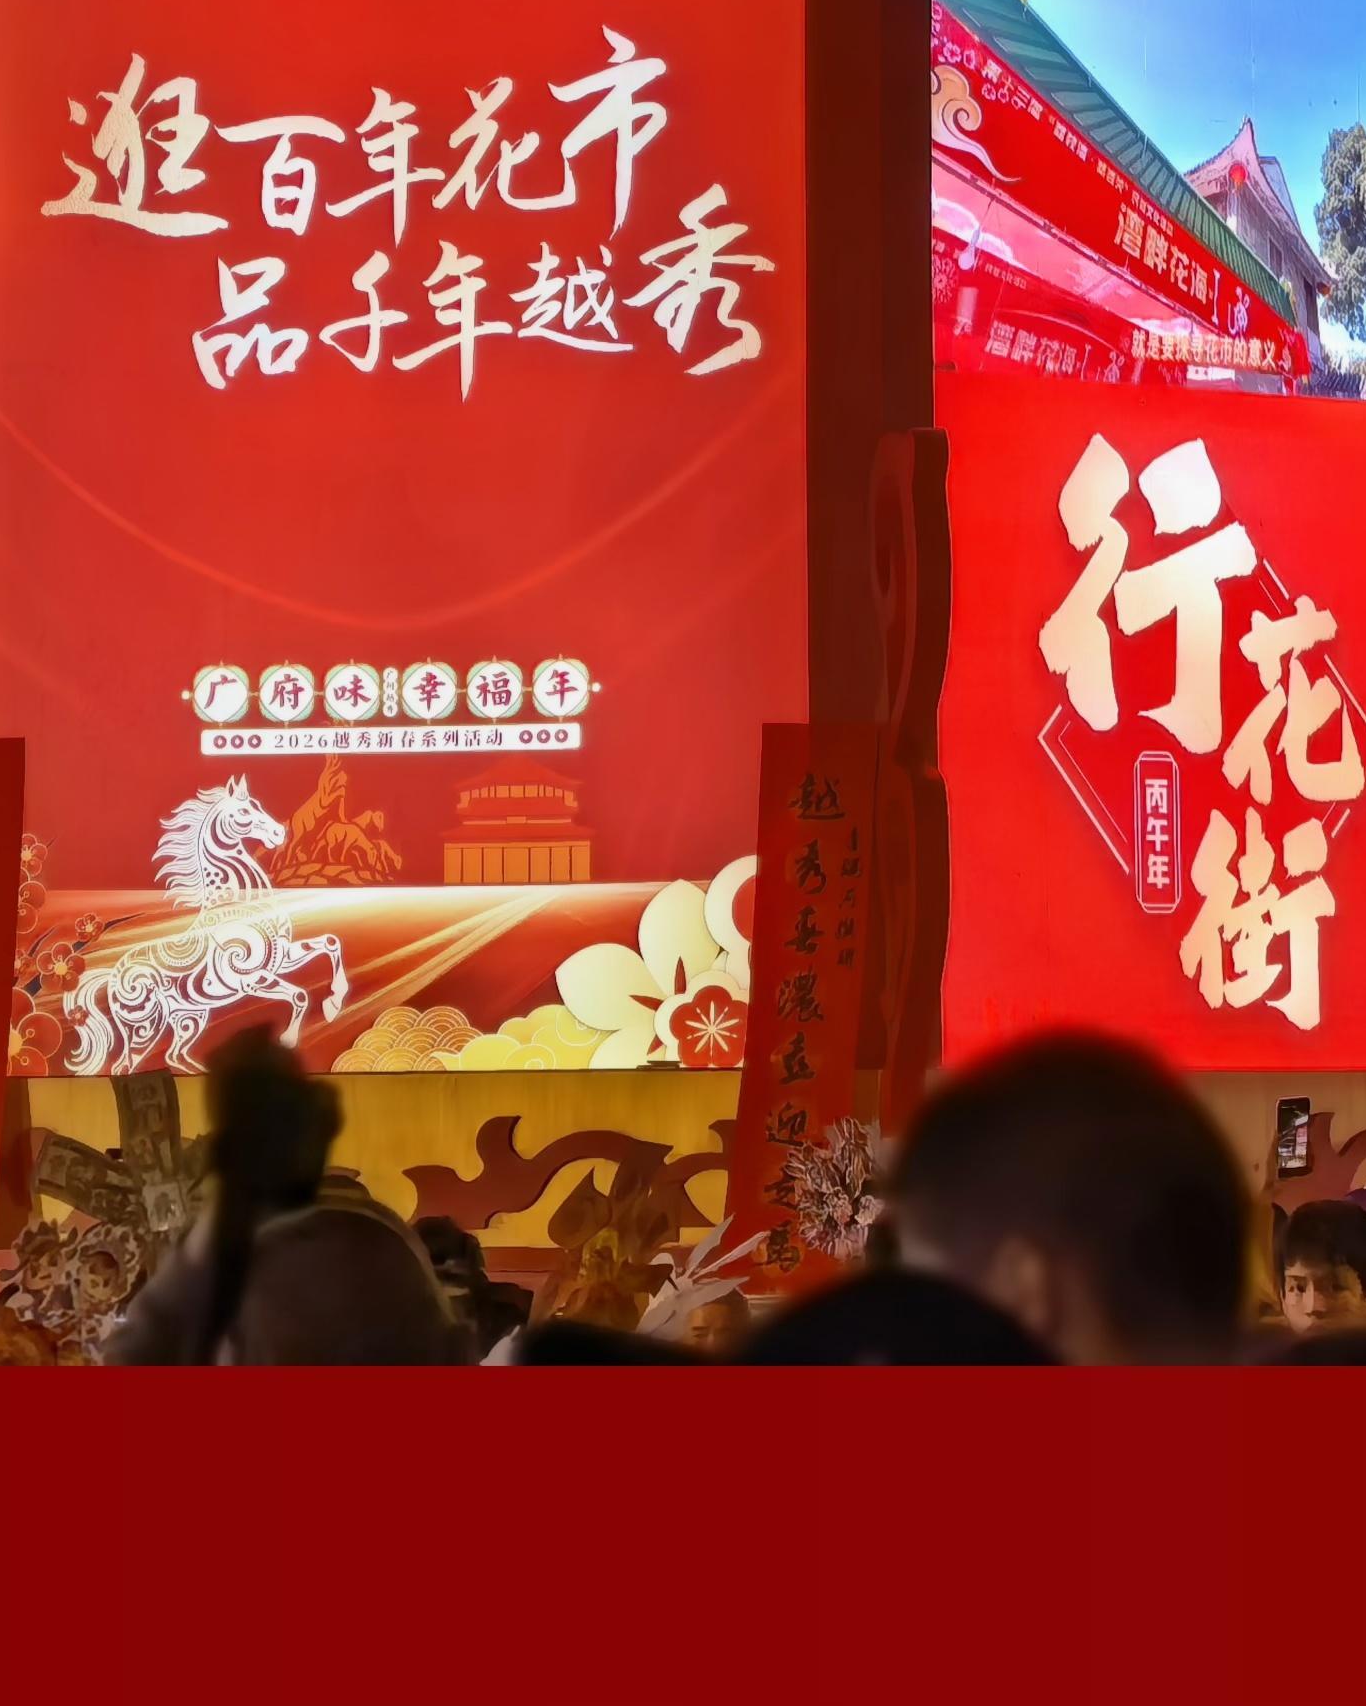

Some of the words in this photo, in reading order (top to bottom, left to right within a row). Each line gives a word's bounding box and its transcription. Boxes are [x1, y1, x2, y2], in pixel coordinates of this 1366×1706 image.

[40, 25, 668, 247] 逛百年花市
[191, 183, 776, 403] 品千年越秀
[203, 668, 580, 713] 广府味幸福年
[1038, 432, 1366, 1032] 行花街
[1143, 778, 1171, 890] 丙午年
